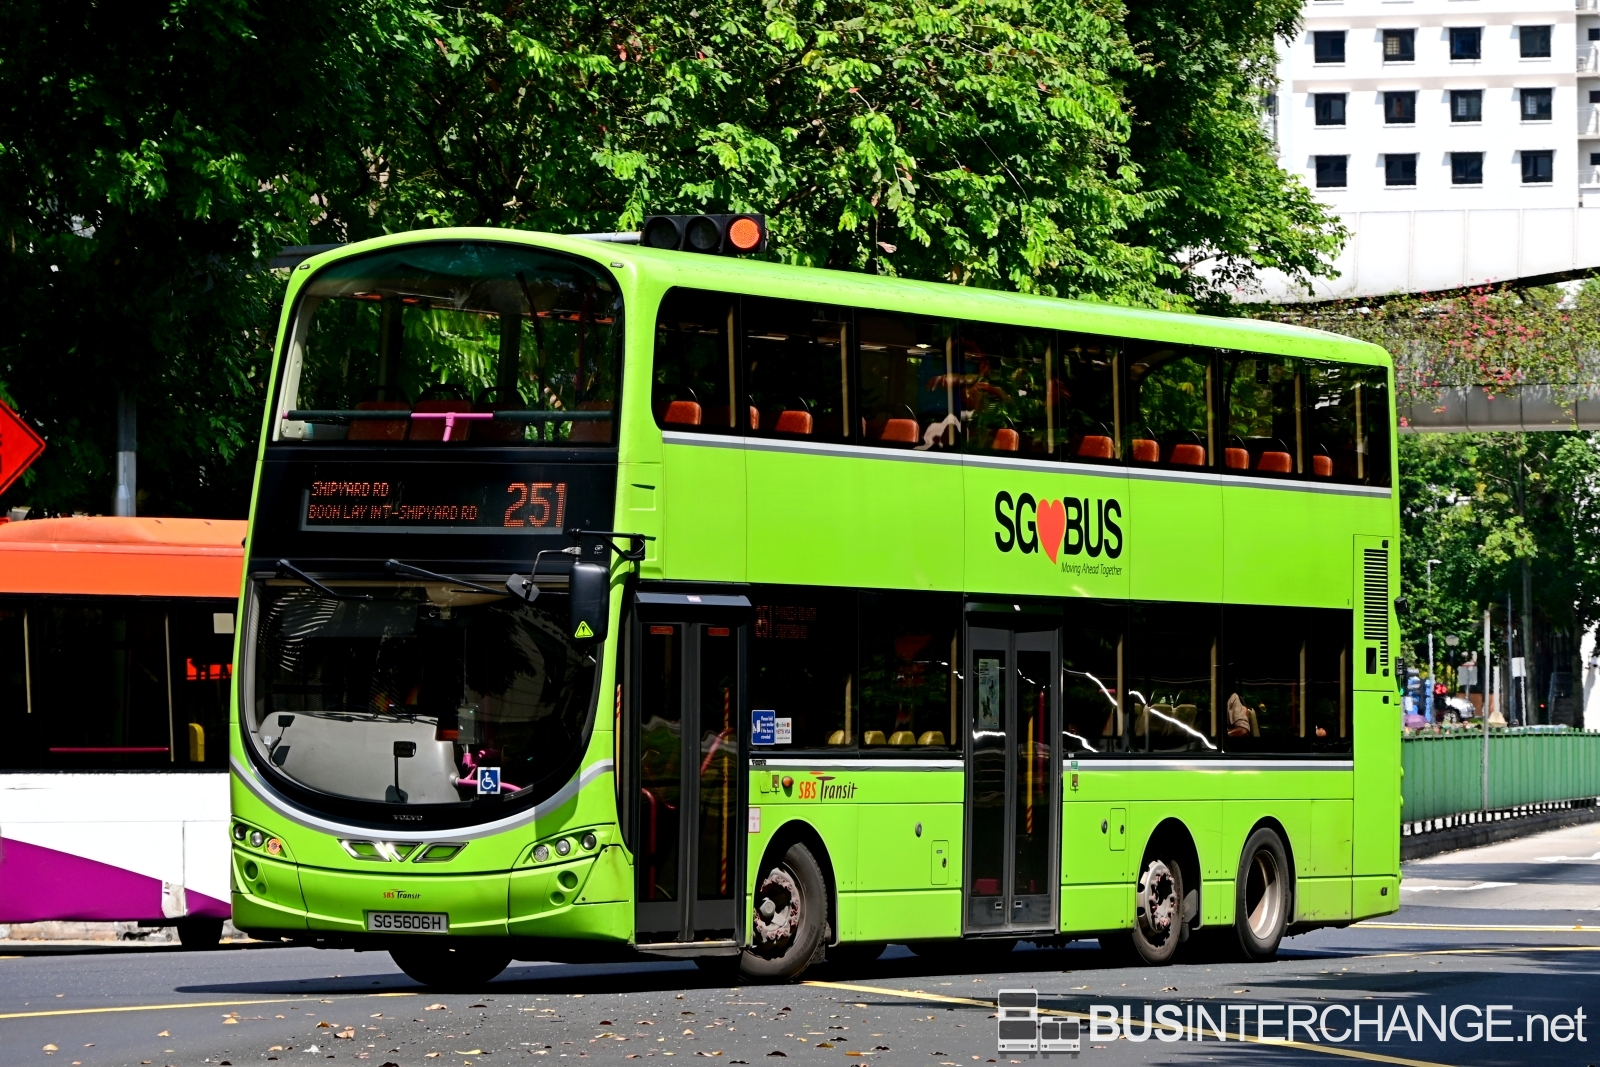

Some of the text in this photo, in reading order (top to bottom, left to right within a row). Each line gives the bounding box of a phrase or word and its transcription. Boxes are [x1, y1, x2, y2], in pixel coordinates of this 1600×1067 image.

[311, 482, 390, 497] SHIPYARD RD
[308, 504, 341, 519] BOON
[343, 504, 367, 519] LAY
[460, 505, 478, 520] RD
[503, 482, 567, 528] 251
[994, 490, 1123, 560] SG BUS
[1060, 562, 1123, 578] Moving Ahead Together
[798, 776, 859, 803] SBS Transit
[382, 890, 422, 900] SBS Transit
[373, 914, 442, 930] SG5606H
